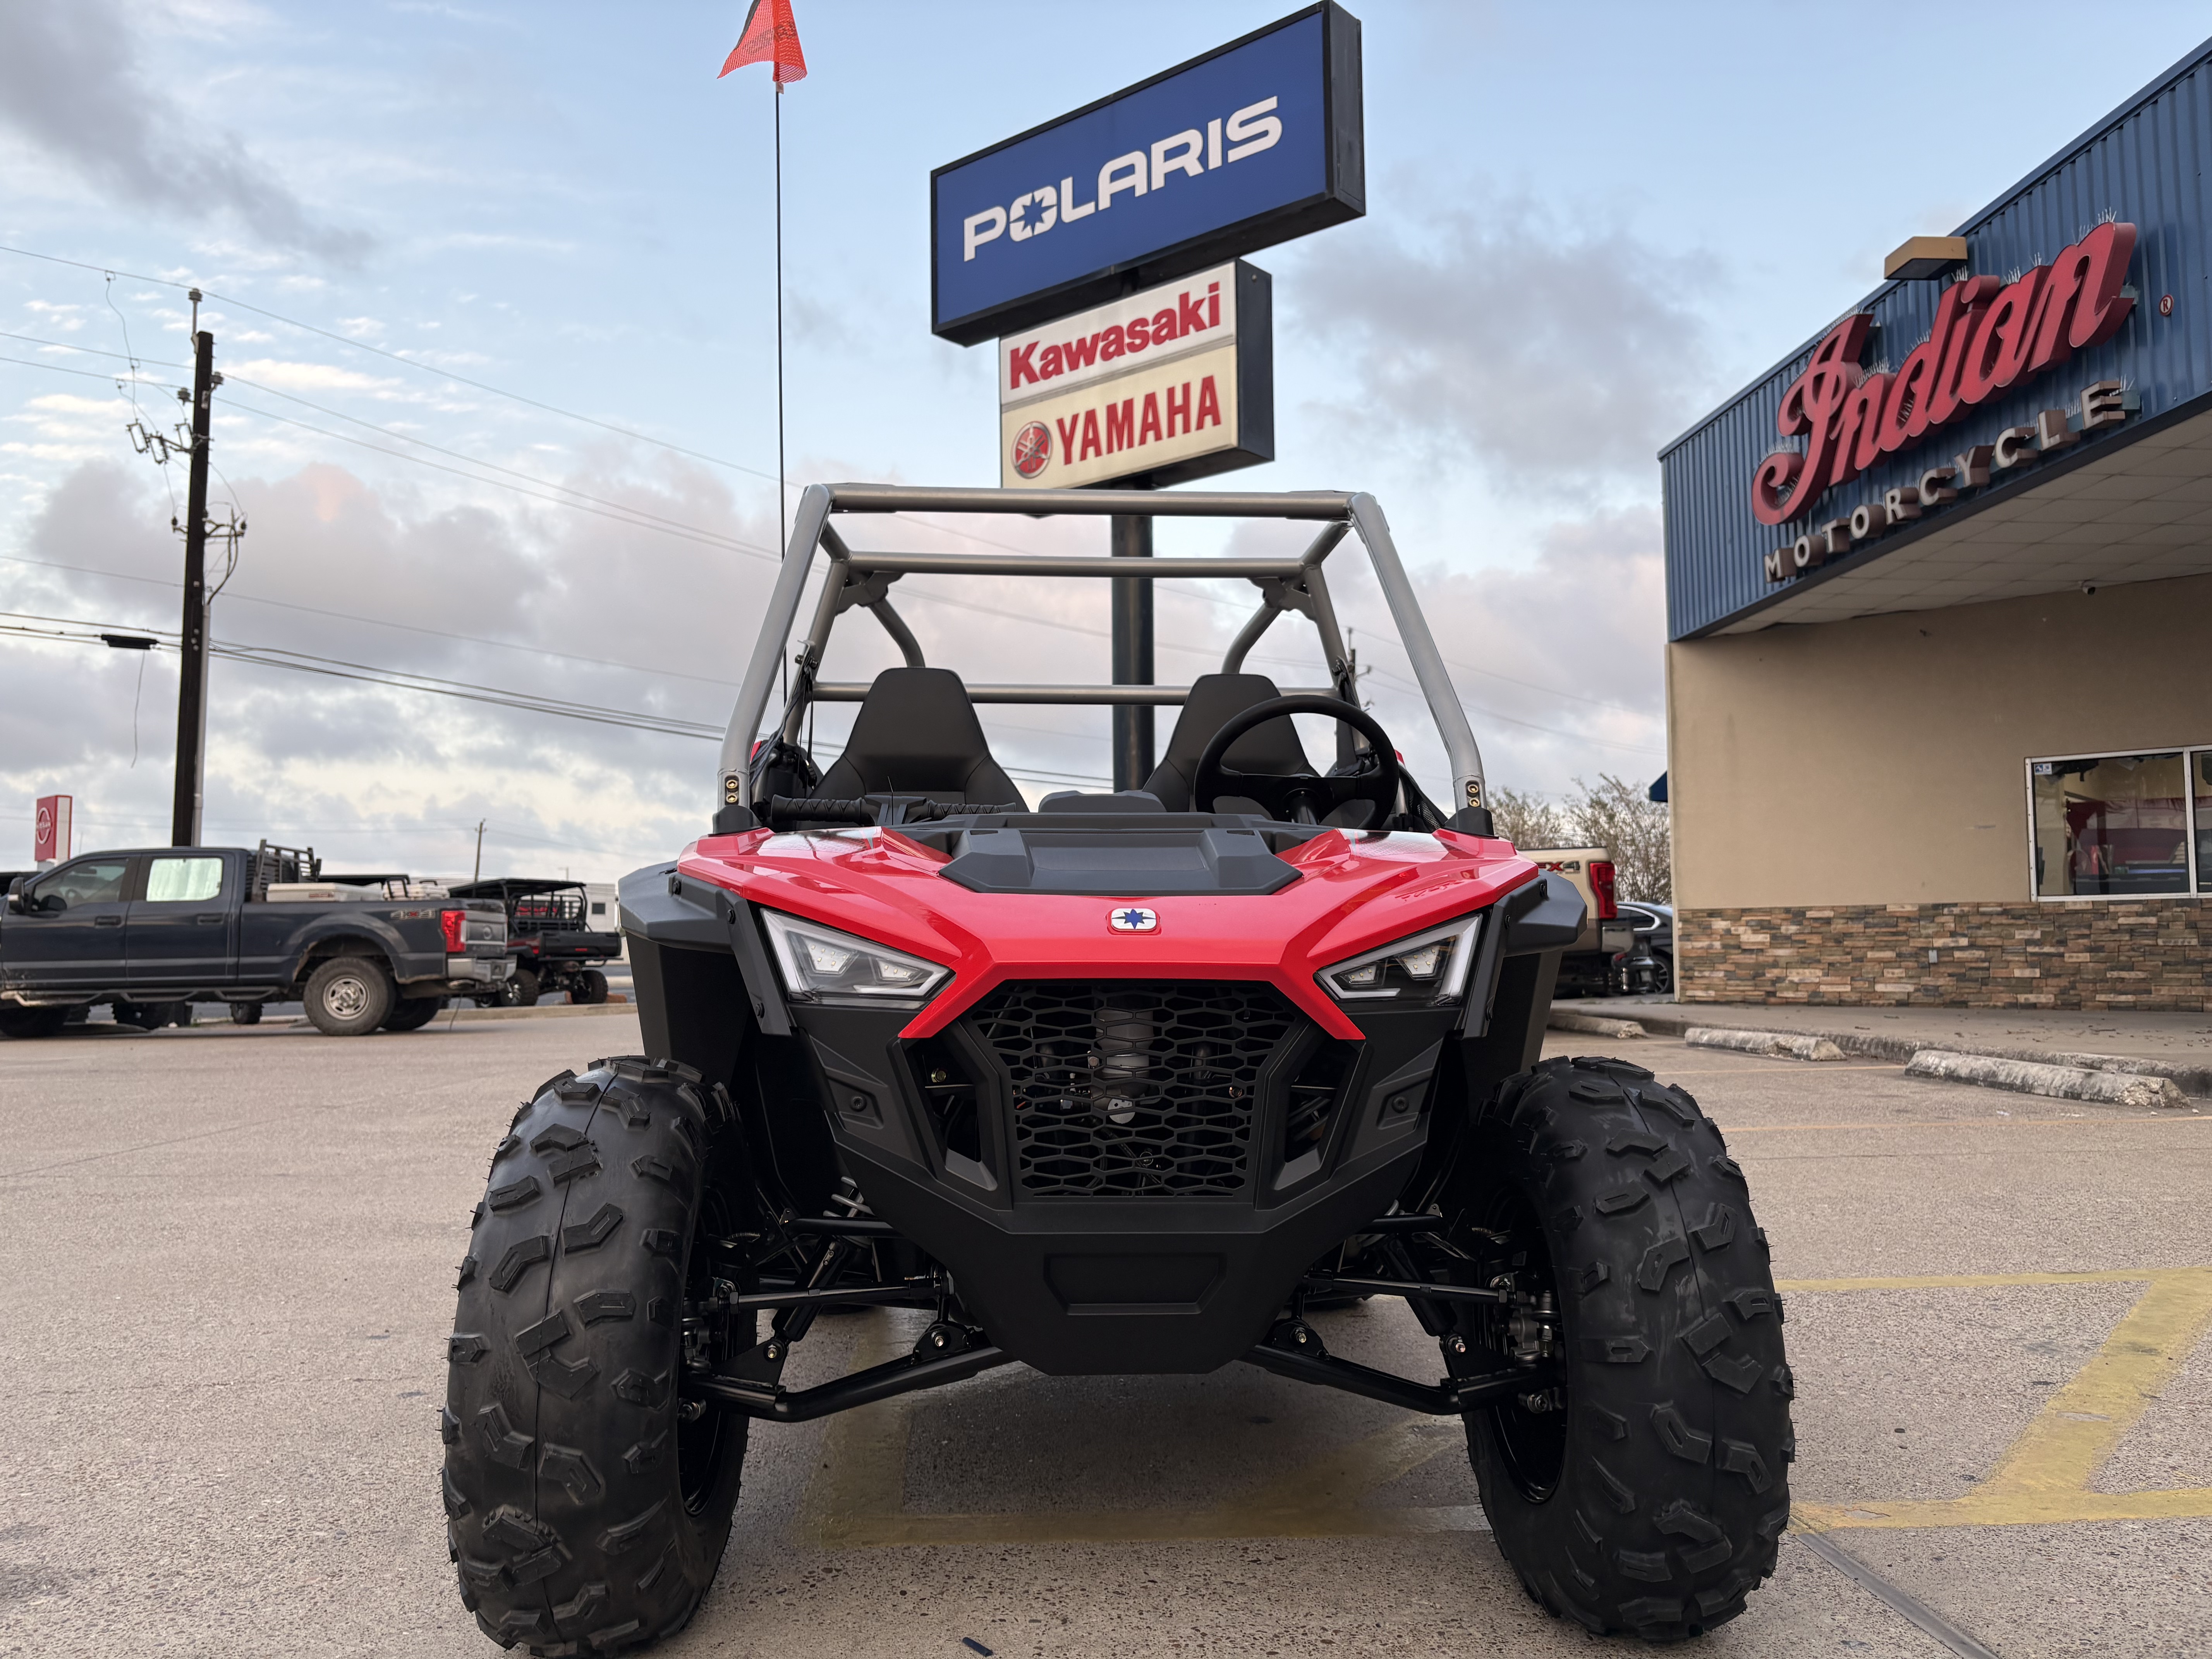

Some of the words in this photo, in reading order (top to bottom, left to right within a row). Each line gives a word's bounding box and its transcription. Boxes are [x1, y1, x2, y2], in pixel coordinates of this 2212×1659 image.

[964, 96, 1282, 262] POLARIS
[1010, 281, 1220, 390] Kawasaki
[1751, 222, 2136, 525] Indian
[1056, 374, 1221, 465] YAMAHA
[1764, 380, 2125, 583] MOTORCYCLE
